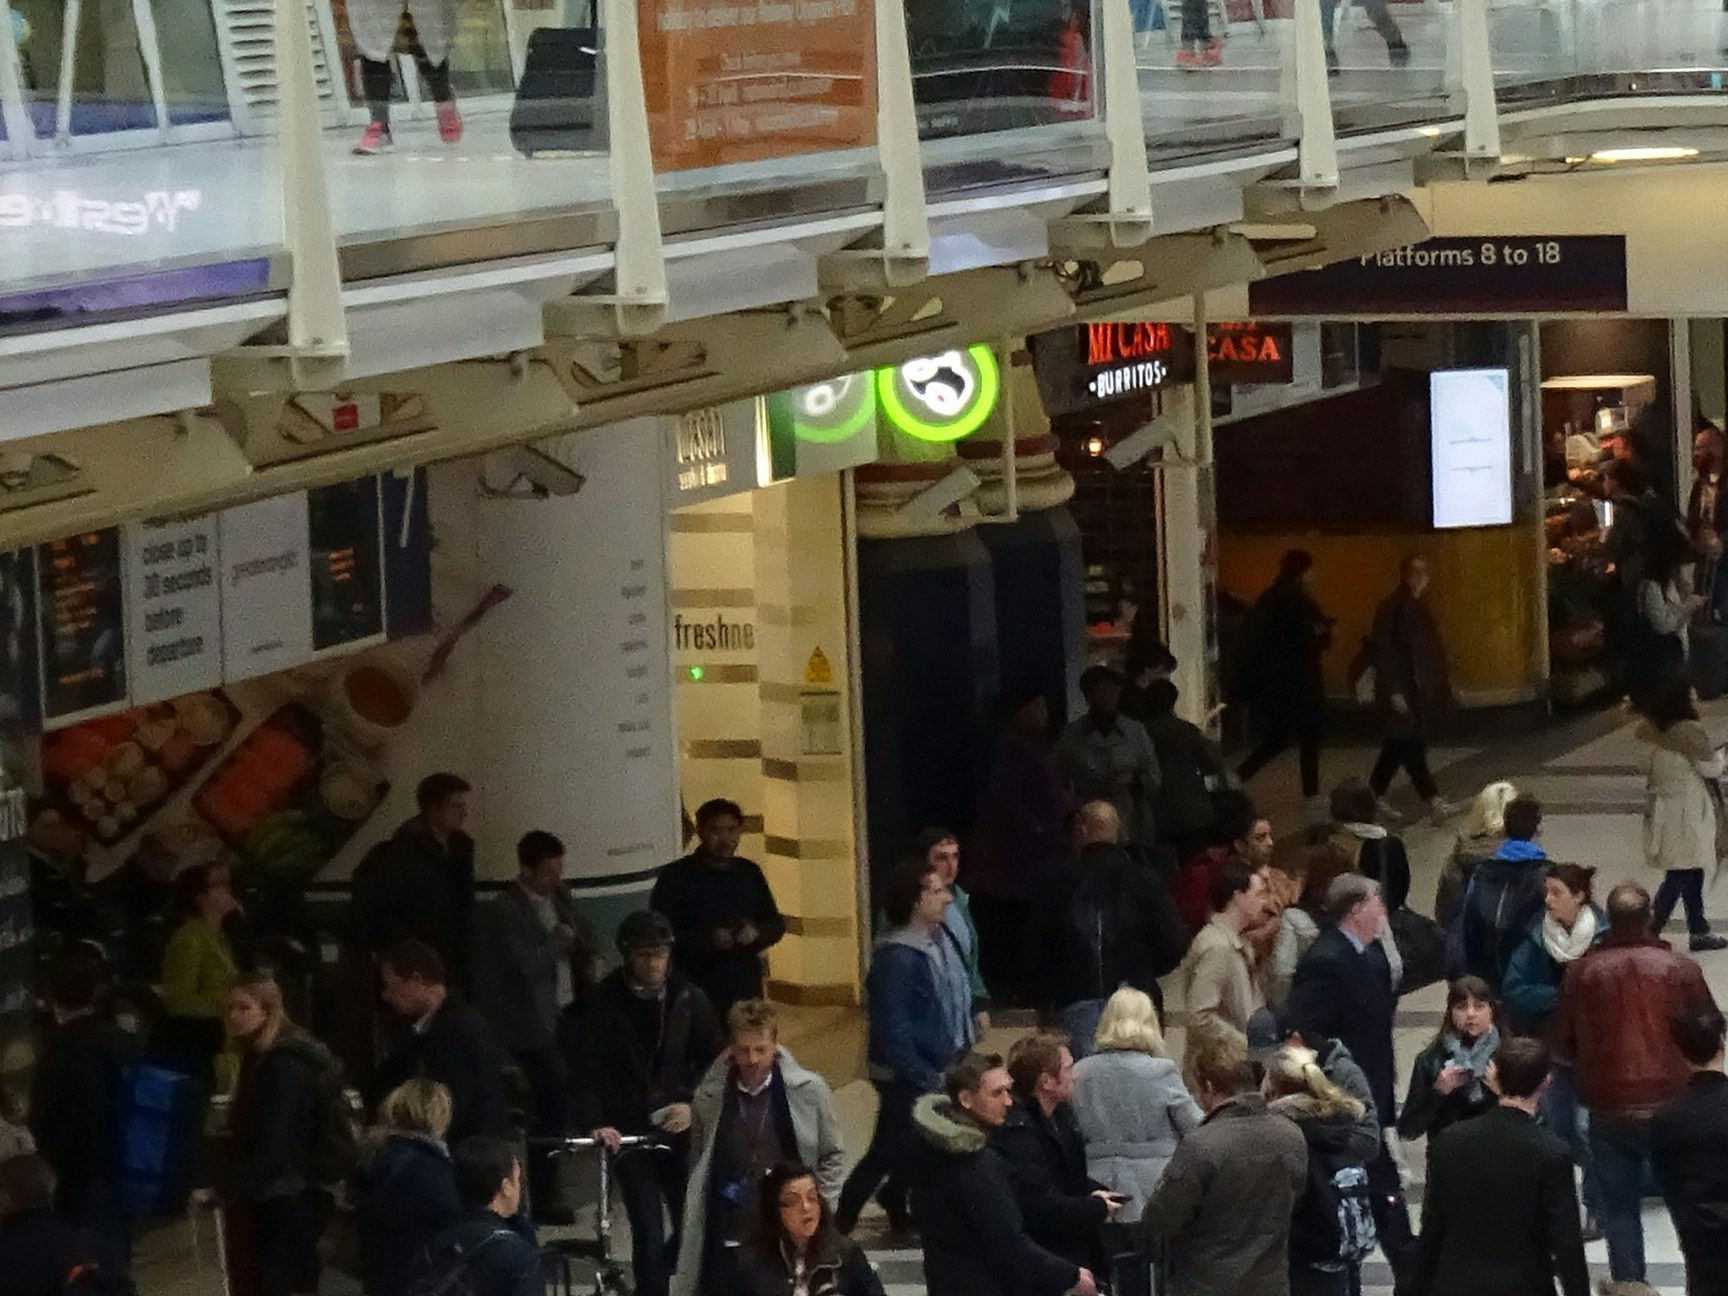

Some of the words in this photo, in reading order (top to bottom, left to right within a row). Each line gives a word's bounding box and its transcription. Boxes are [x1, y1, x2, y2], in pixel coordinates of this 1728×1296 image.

[1481, 243, 1497, 265] 8
[1502, 245, 1528, 265] to
[1535, 242, 1561, 264] 18
